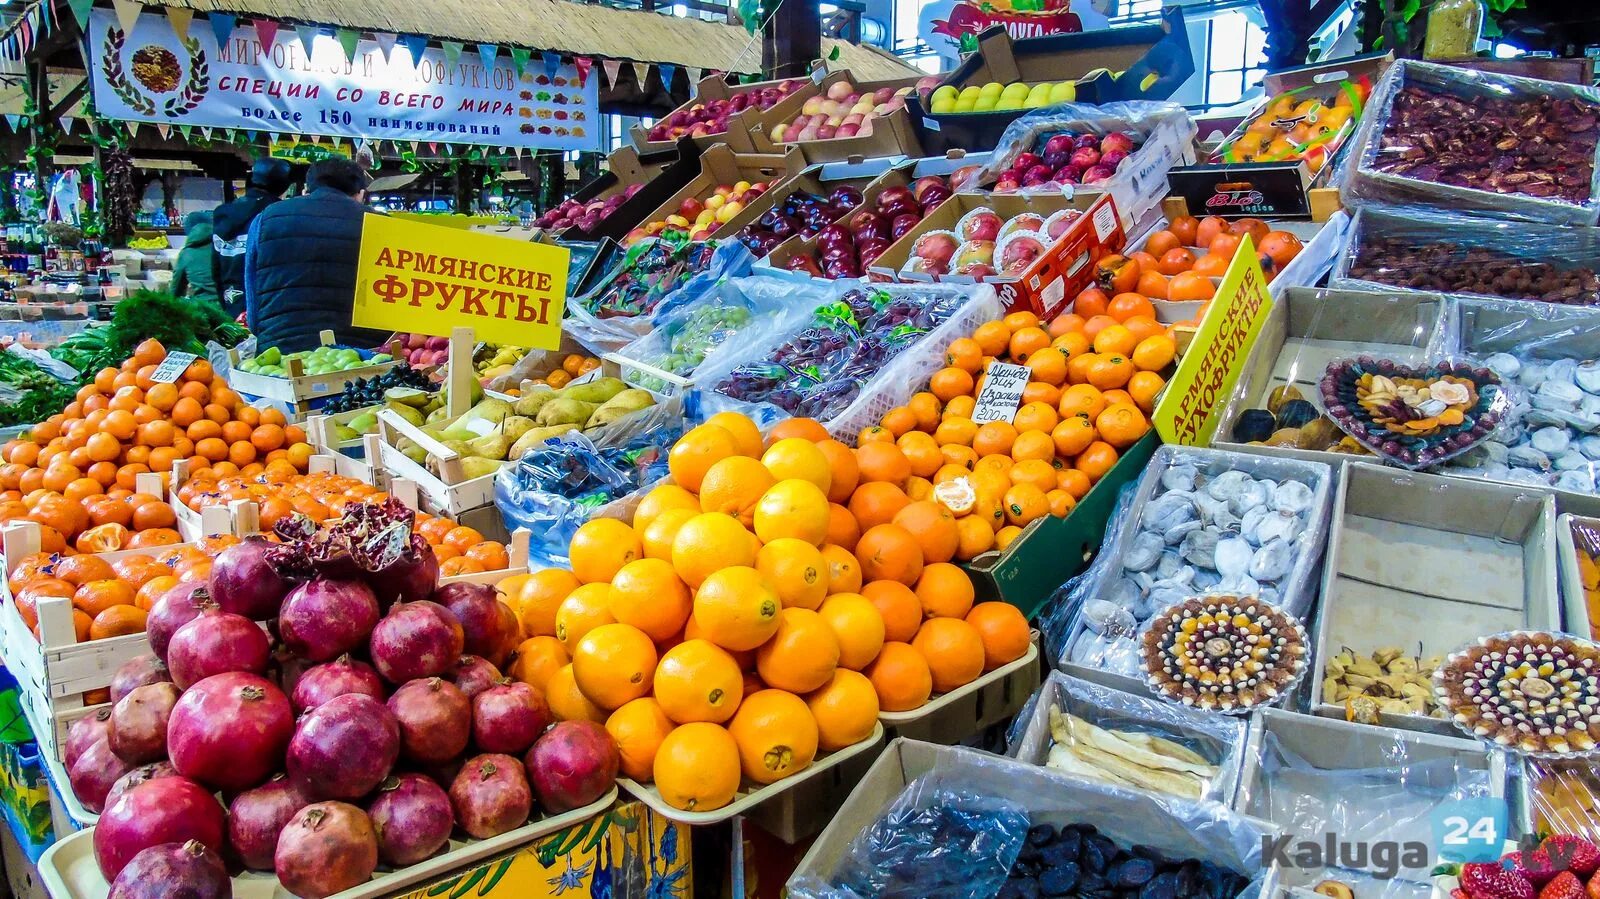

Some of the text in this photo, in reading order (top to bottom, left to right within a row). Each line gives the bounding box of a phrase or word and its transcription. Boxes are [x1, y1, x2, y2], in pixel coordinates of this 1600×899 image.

[990, 20, 1043, 40] ЛУГА
[217, 37, 262, 66] МИР
[273, 43, 353, 75] ОРЕВ
[363, 52, 373, 77] И
[218, 76, 514, 116] СПЕЦИИ СО ВСЕГО МИРА
[241, 107, 501, 136] Более 150 наименований
[375, 247, 552, 292] АРМЯНСКИЕ
[372, 274, 551, 325] ФРУКТЫ
[1173, 267, 1255, 437] АРМЯНСКИЕ
[1179, 283, 1264, 447] СУХОФРУКТЫ
[976, 408, 1000, 421] 200
